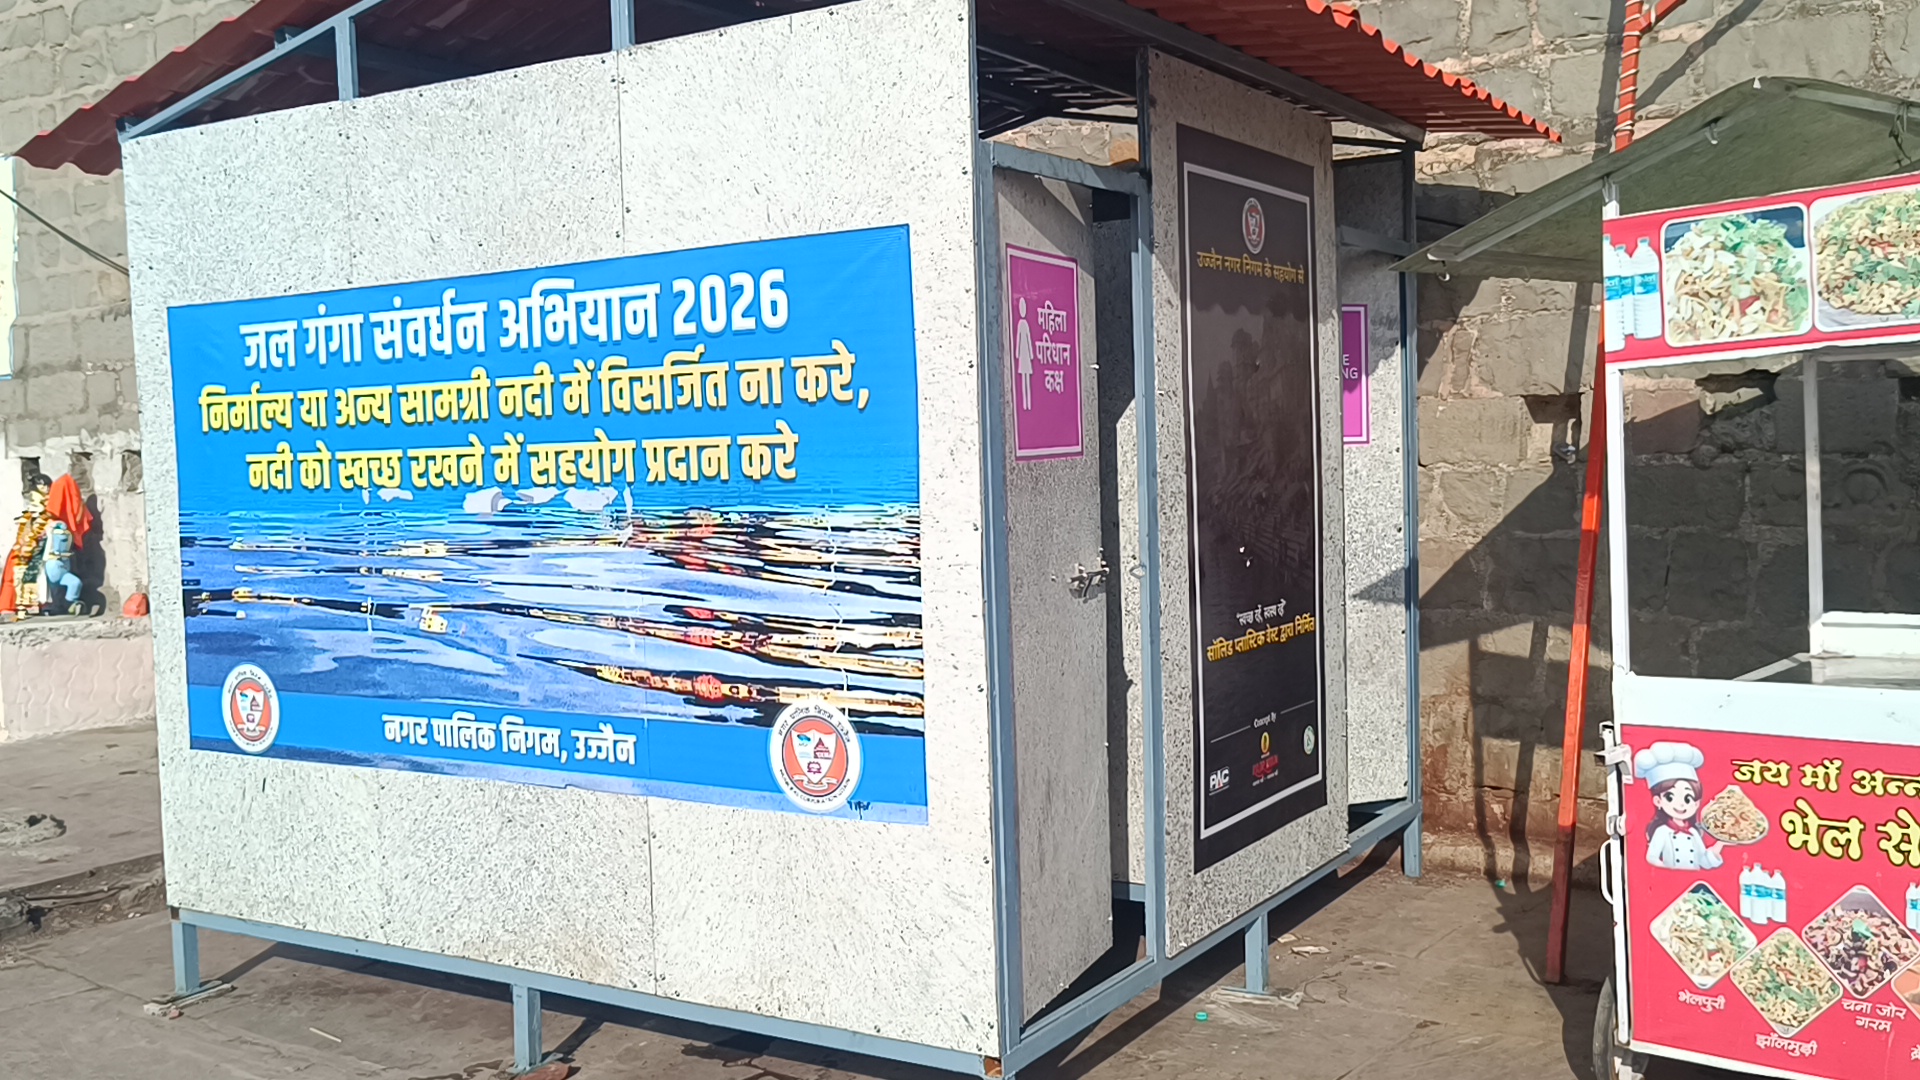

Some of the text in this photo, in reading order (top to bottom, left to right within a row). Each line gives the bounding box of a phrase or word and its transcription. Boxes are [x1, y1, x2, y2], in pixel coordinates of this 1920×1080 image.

[239, 268, 789, 370] जल गंगा संवर्धन अभियान 2026
[1037, 300, 1067, 334] महिला
[1035, 333, 1071, 366] परिधान
[199, 338, 870, 433] निर्माल्य या अन्य सामग्री नदी में विसर्जित ना करे,
[1044, 370, 1065, 394] कक्ष
[246, 419, 799, 491] नदी को स्वच्छ रखने में सहयोग प्रदान करे
[381, 710, 637, 765] नगर पालिक निगम, उज्जैन
[1731, 758, 1791, 787] जय
[1780, 797, 1866, 861] भेल
[1678, 989, 1726, 1013] भेलपुरी
[1841, 998, 1907, 1020] चना जोर
[1855, 1015, 1893, 1033] गरम
